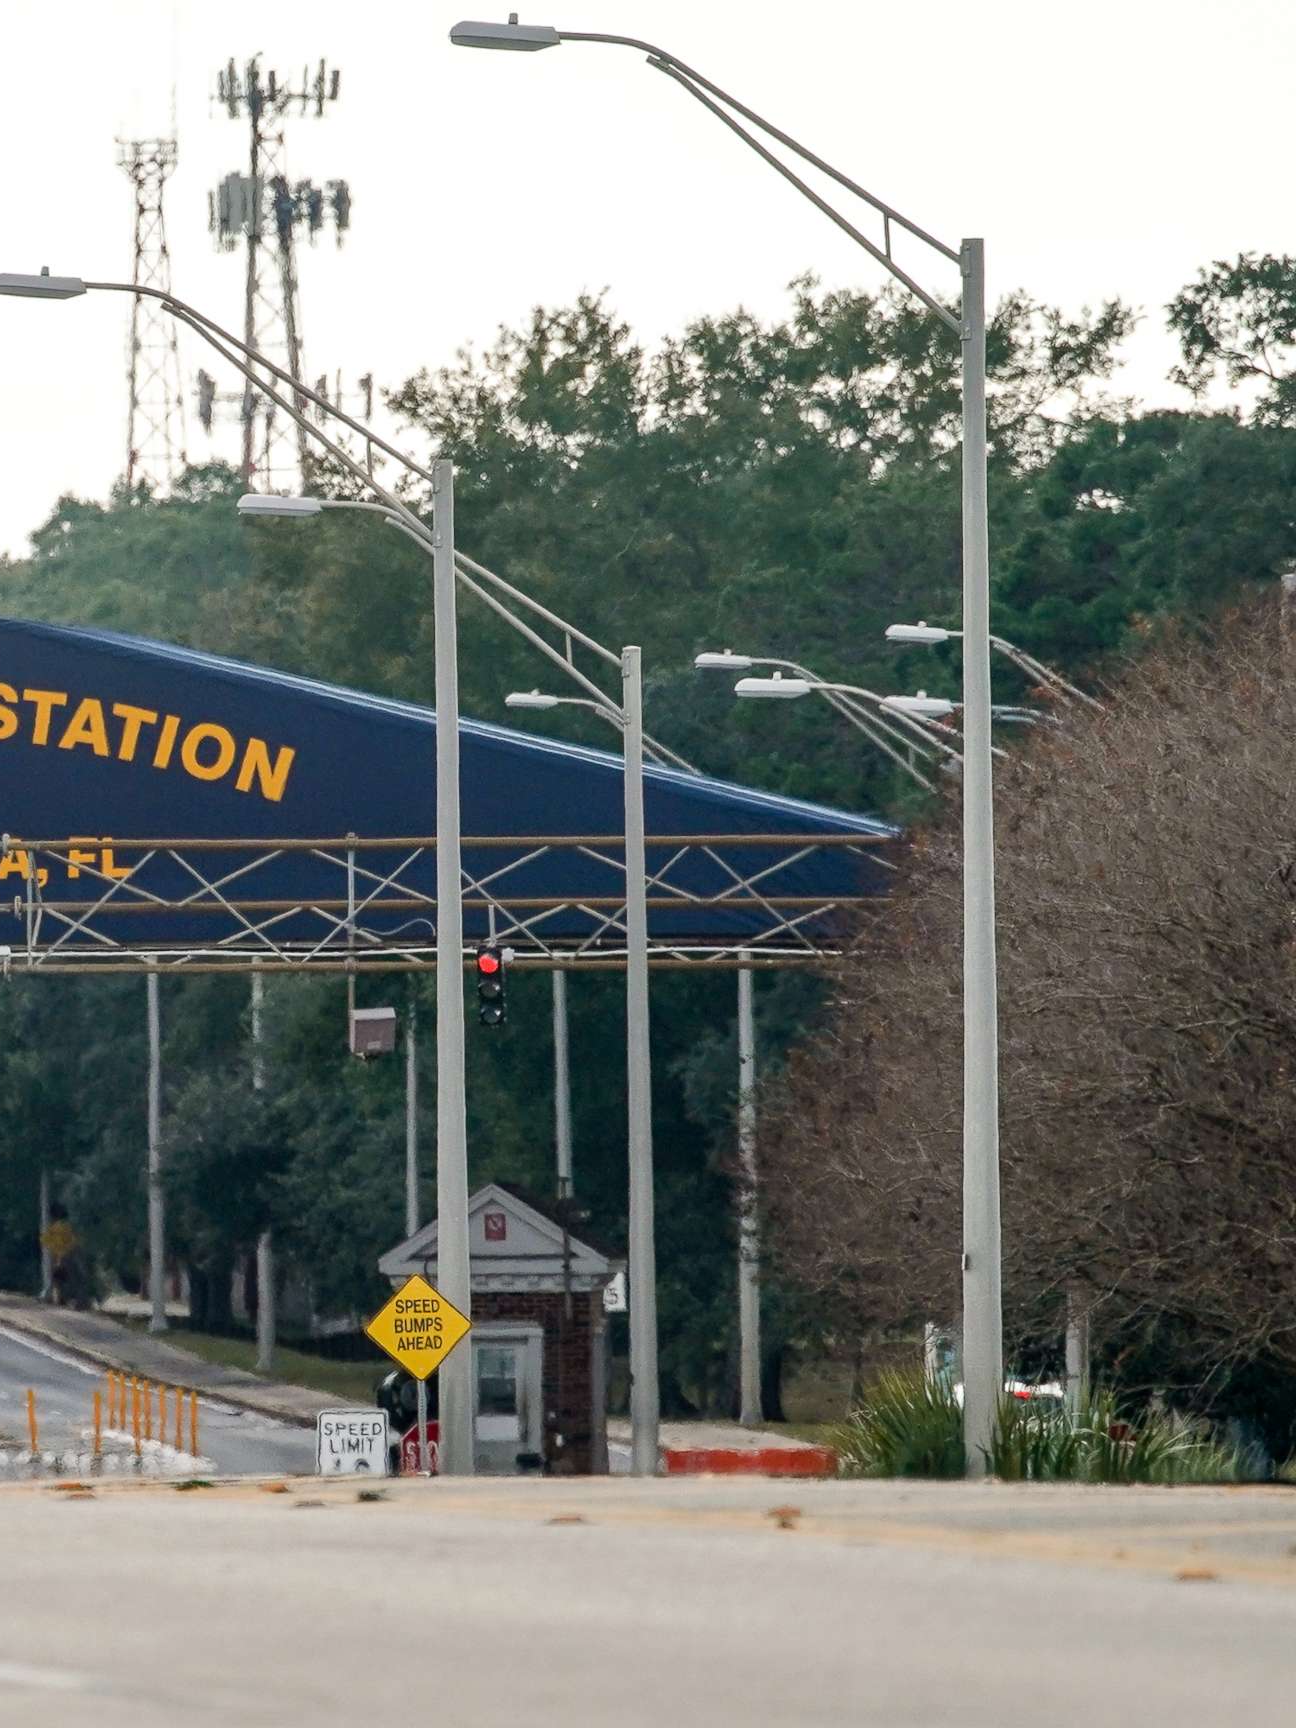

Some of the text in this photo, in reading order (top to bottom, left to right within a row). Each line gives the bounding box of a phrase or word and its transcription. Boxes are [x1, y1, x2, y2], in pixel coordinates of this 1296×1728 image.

[67, 836, 136, 879] FL
[395, 1299, 440, 1314] SPEED
[394, 1316, 443, 1334] BUMPS
[397, 1335, 443, 1352] AHEAD
[324, 1422, 383, 1436] SPEED
[329, 1438, 375, 1454] LIMIT
